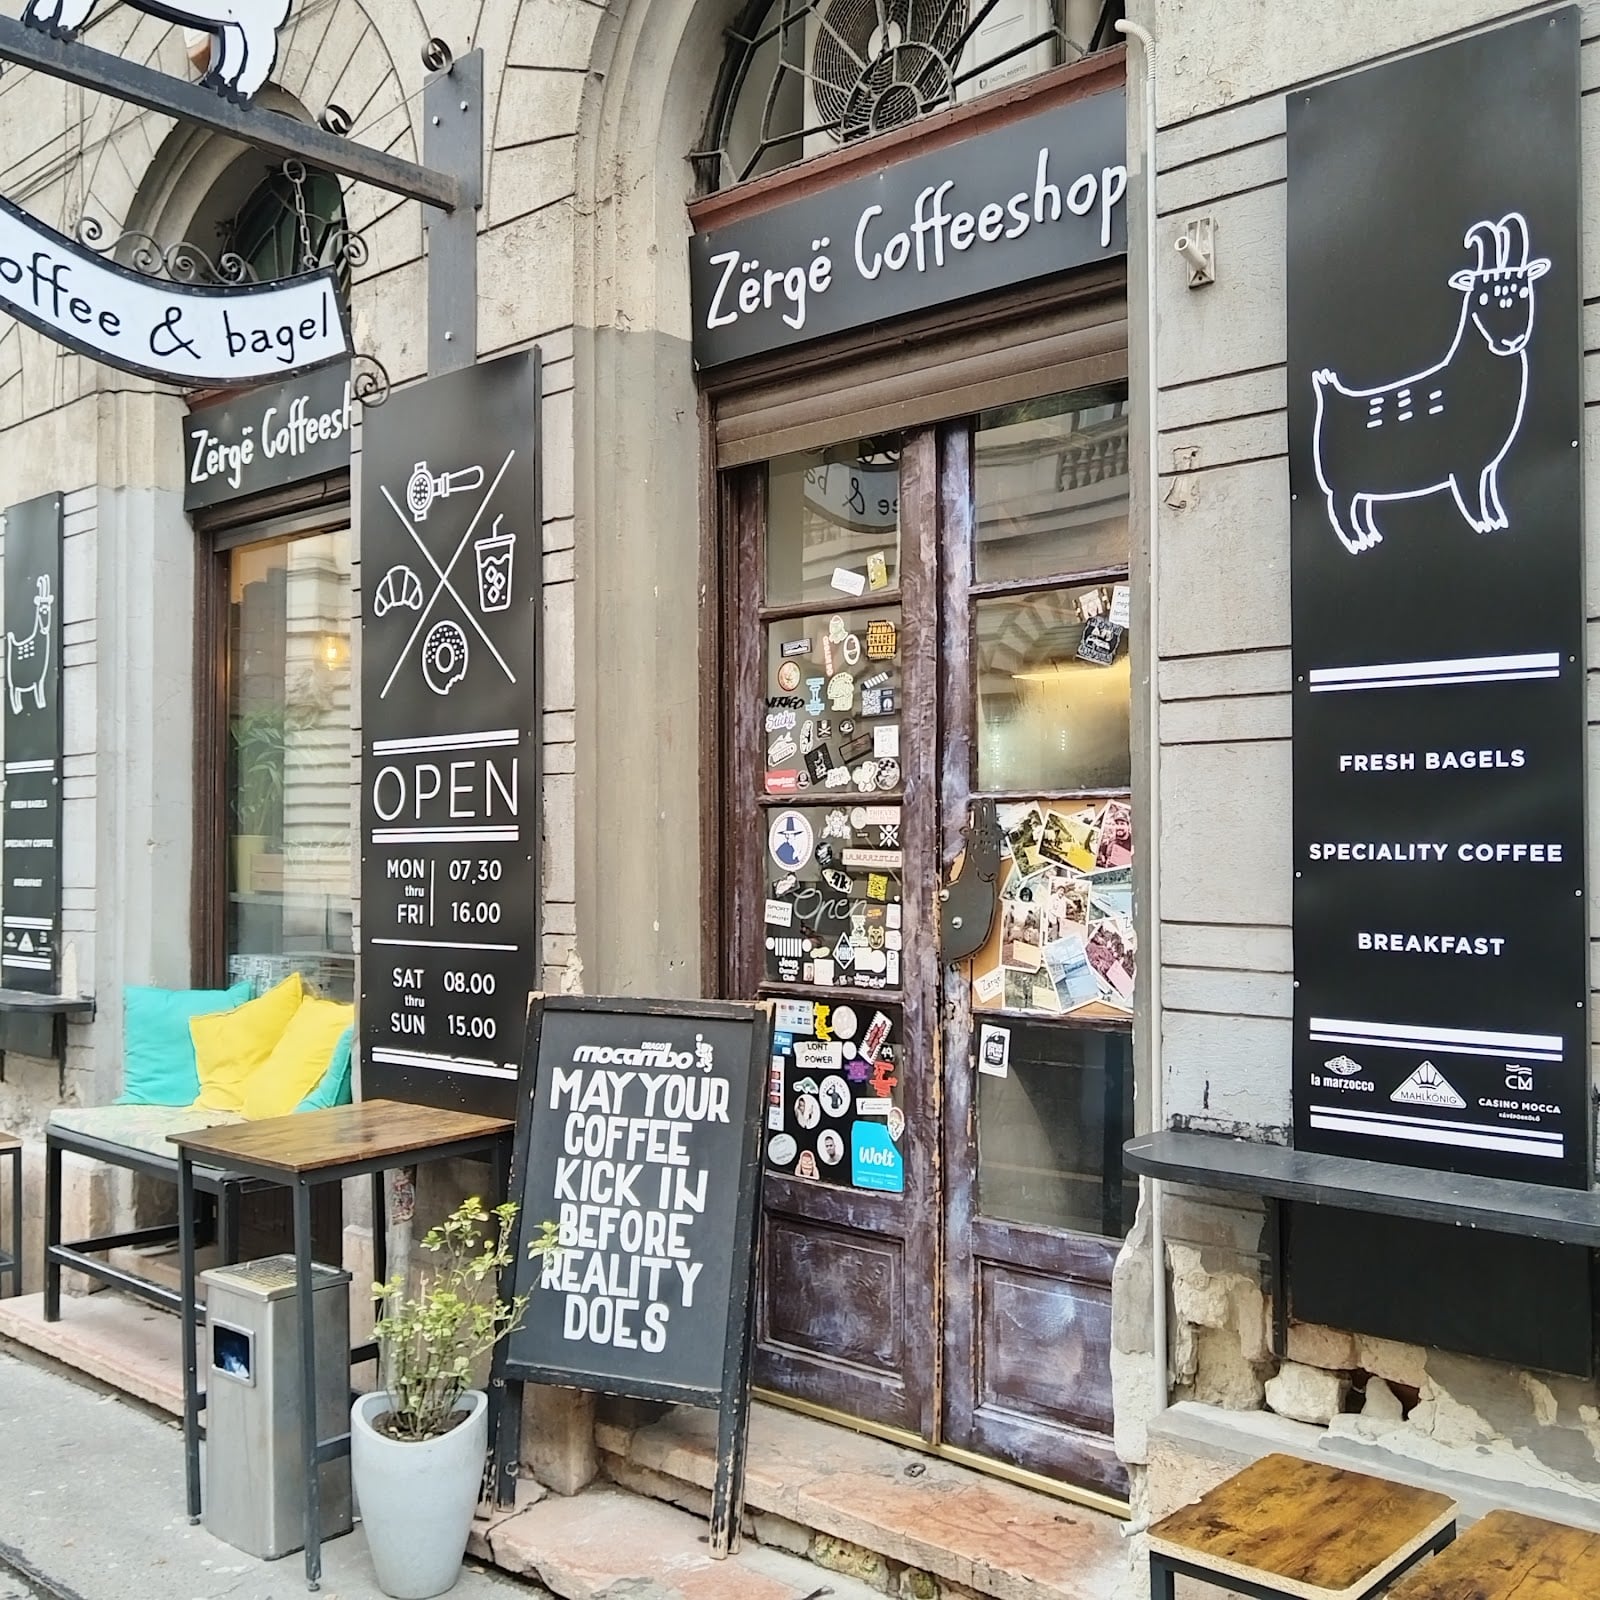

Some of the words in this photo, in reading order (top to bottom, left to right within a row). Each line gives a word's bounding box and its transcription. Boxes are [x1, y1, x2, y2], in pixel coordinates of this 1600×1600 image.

[707, 237, 832, 329] Zërgë
[854, 147, 1127, 280] Coffeeshop
[149, 306, 201, 360] &
[223, 291, 328, 364] bagel
[190, 426, 254, 489] Zërgë
[1339, 753, 1415, 772] FRESH
[1425, 749, 1525, 770] BAGELS
[373, 758, 518, 821] OPEN
[1309, 843, 1449, 861] SPECIALITY
[1457, 843, 1563, 862] COFFEE
[387, 859, 425, 879] MON
[449, 859, 502, 885] 07.30
[405, 884, 425, 897] thru
[397, 903, 424, 924] FRI
[451, 901, 501, 924] 16.00
[1358, 932, 1505, 956] BREAKFAST
[392, 967, 425, 989] SAT
[443, 971, 496, 995] 08.00
[404, 994, 425, 1008] thru
[391, 1012, 425, 1035] SUN
[447, 1014, 496, 1039] 15.00
[573, 1043, 694, 1070] mocambo
[641, 1042, 665, 1051] DRAGO
[805, 1055, 833, 1064] POWER
[550, 1067, 637, 1115] MAY
[638, 1072, 731, 1123] YOUR
[1310, 1073, 1321, 1086] la
[1323, 1077, 1375, 1093] marzocco
[1505, 1075, 1533, 1091] CM
[1478, 1097, 1519, 1110] CASINO
[1521, 1102, 1561, 1114] MOCCA
[564, 1112, 693, 1166] COFFEE
[859, 1147, 895, 1168] Wolt
[554, 1157, 644, 1207] KICK
[659, 1166, 709, 1213] IN
[558, 1203, 694, 1259] BEFORE
[540, 1247, 703, 1308] REALITY
[563, 1294, 670, 1353] DOES
